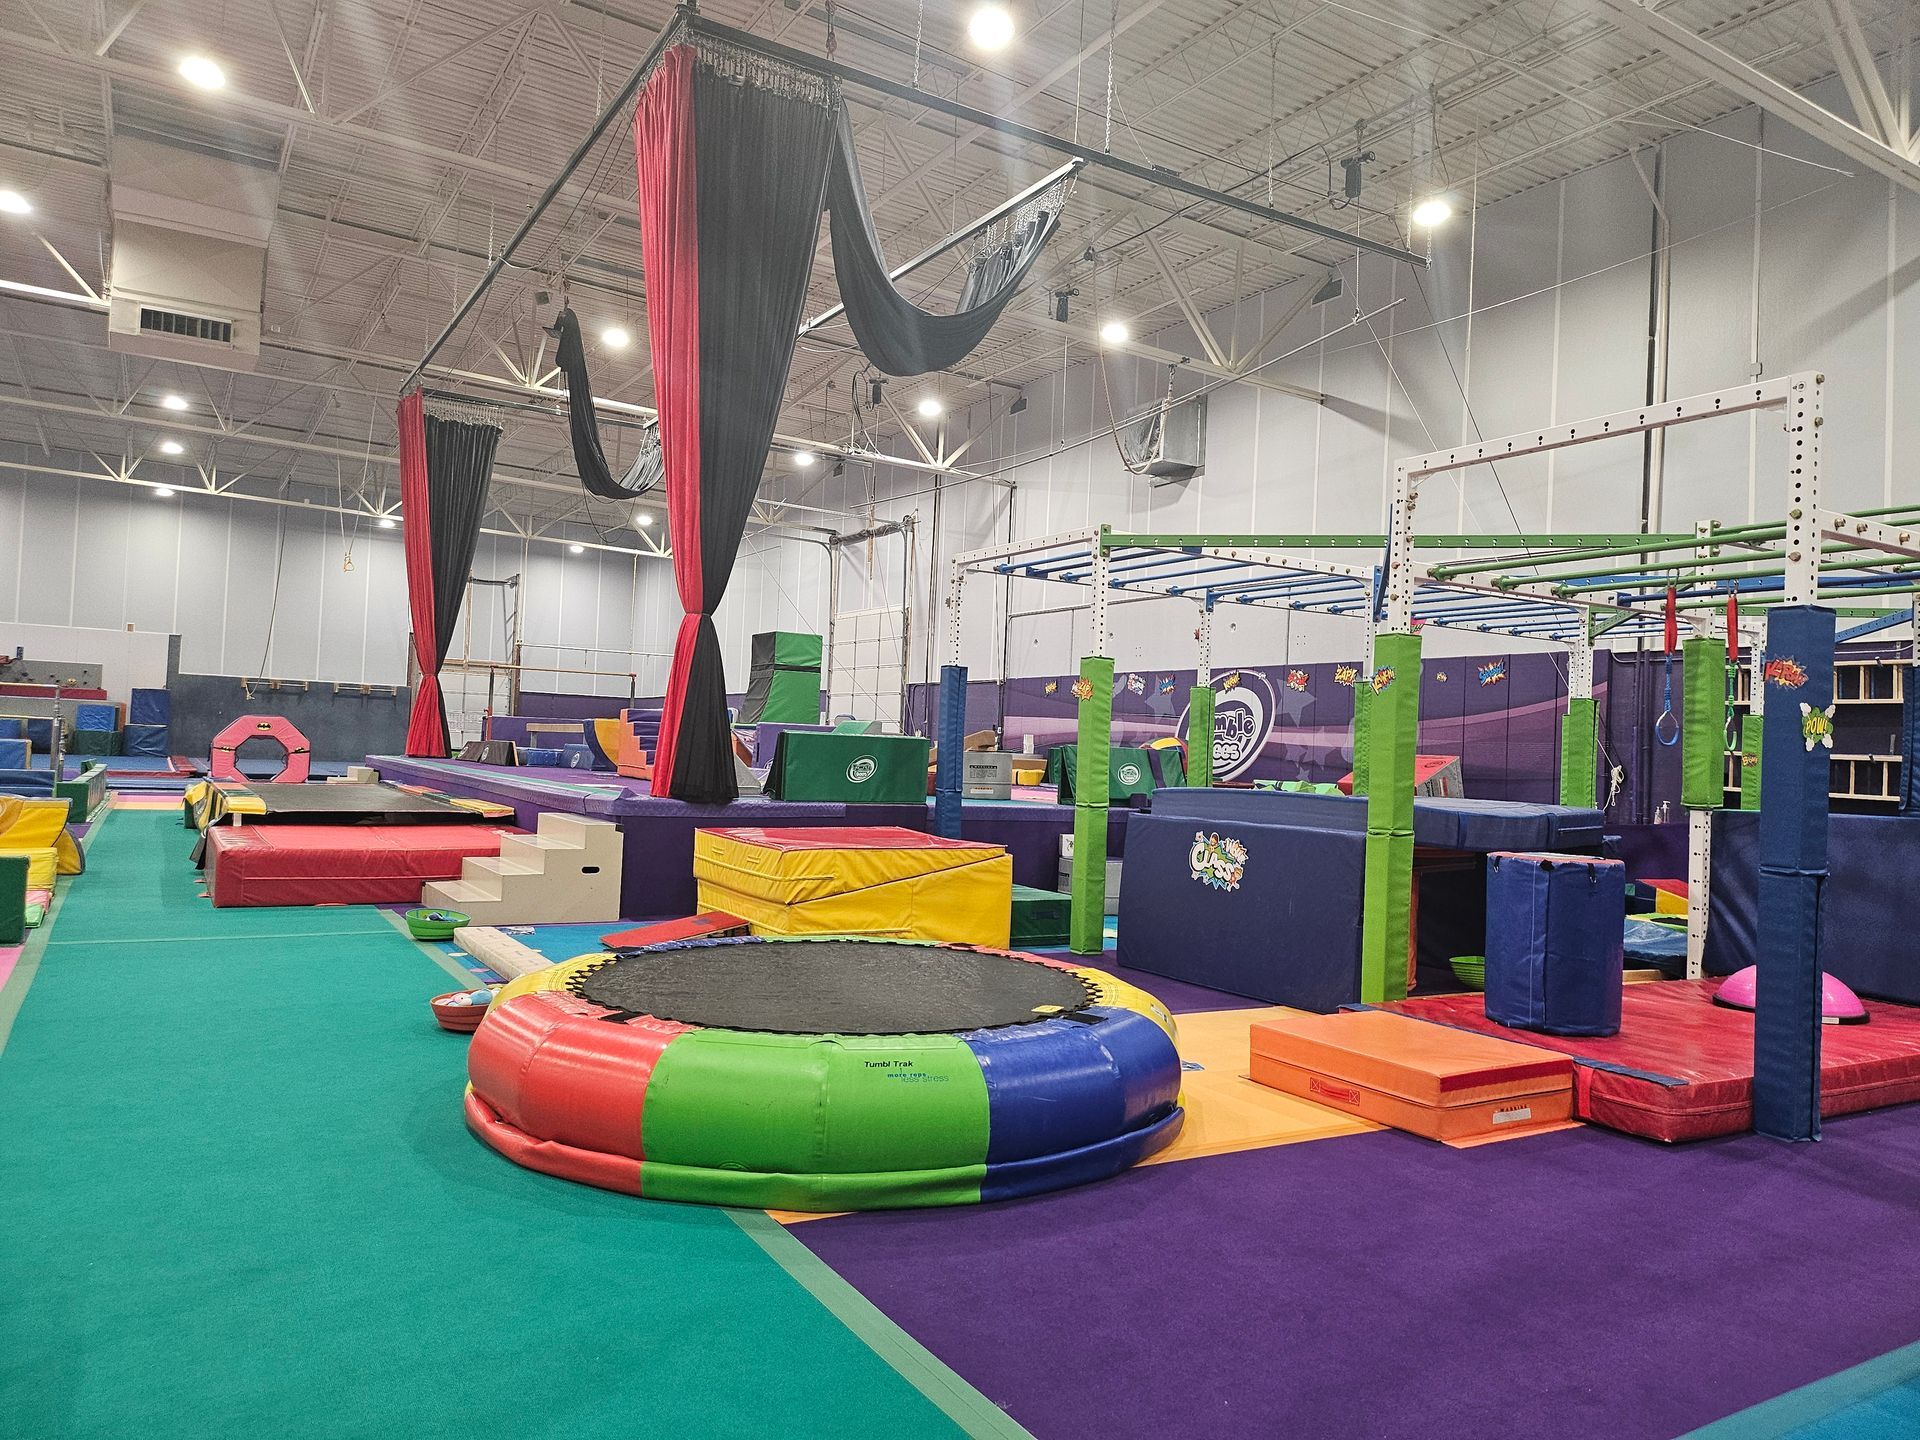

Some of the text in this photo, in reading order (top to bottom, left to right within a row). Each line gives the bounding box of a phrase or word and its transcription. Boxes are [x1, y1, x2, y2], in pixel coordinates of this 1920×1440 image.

[1214, 710, 1254, 739] mble
[1806, 717, 1827, 735] POW!
[1213, 742, 1240, 760] ees
[922, 1074, 950, 1083] stress
